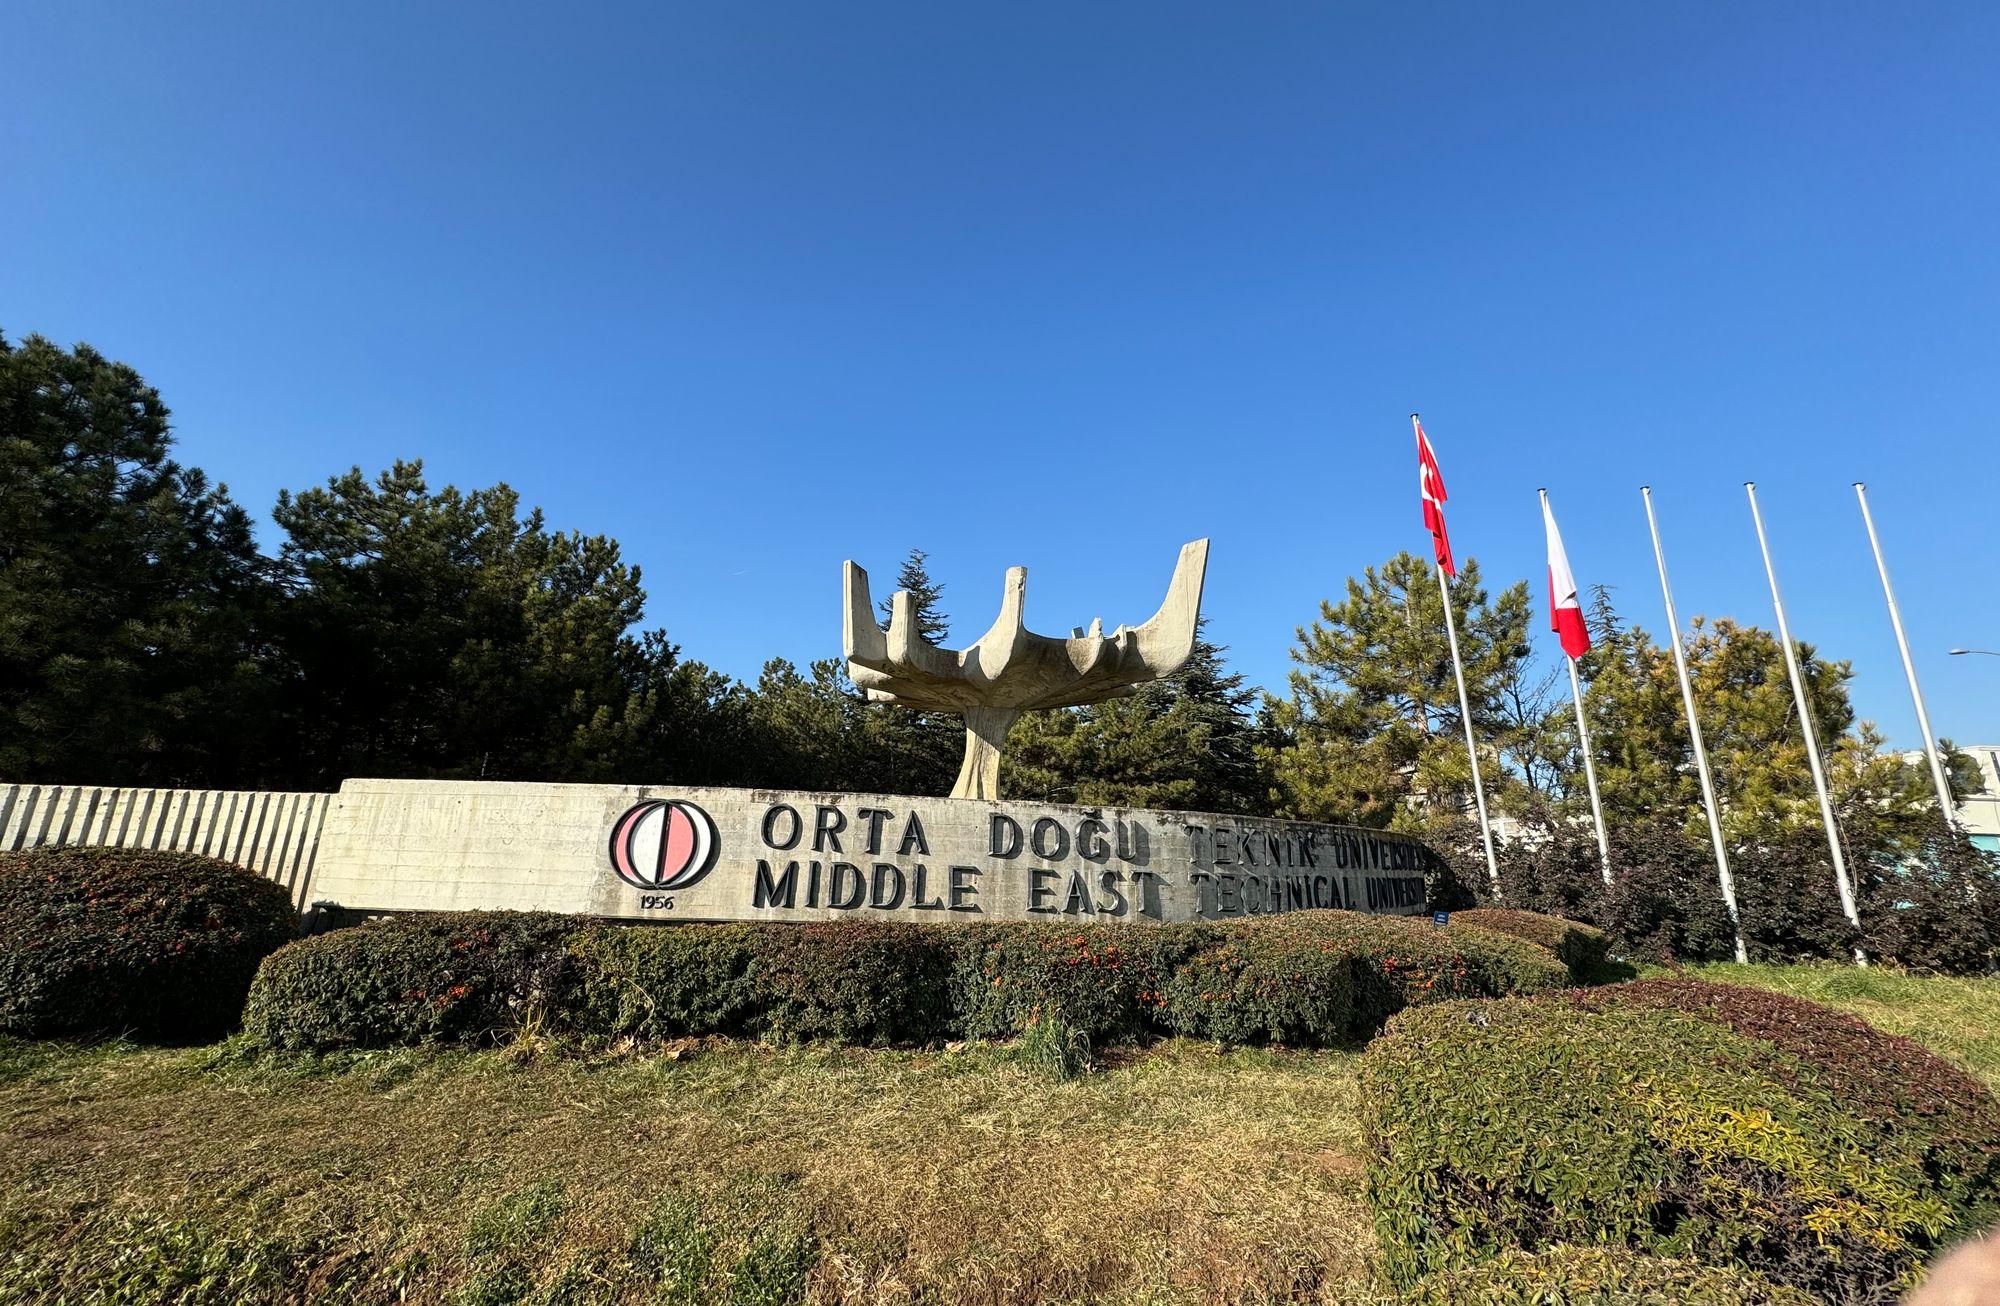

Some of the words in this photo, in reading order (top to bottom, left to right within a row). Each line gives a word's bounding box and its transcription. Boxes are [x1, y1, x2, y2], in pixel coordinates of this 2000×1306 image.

[761, 803, 930, 855] ORTA
[640, 895, 675, 910] 1956
[752, 859, 981, 912] MIDDLE
[1027, 867, 1153, 913] EAST
[1188, 872, 1356, 913] TECHNICAL
